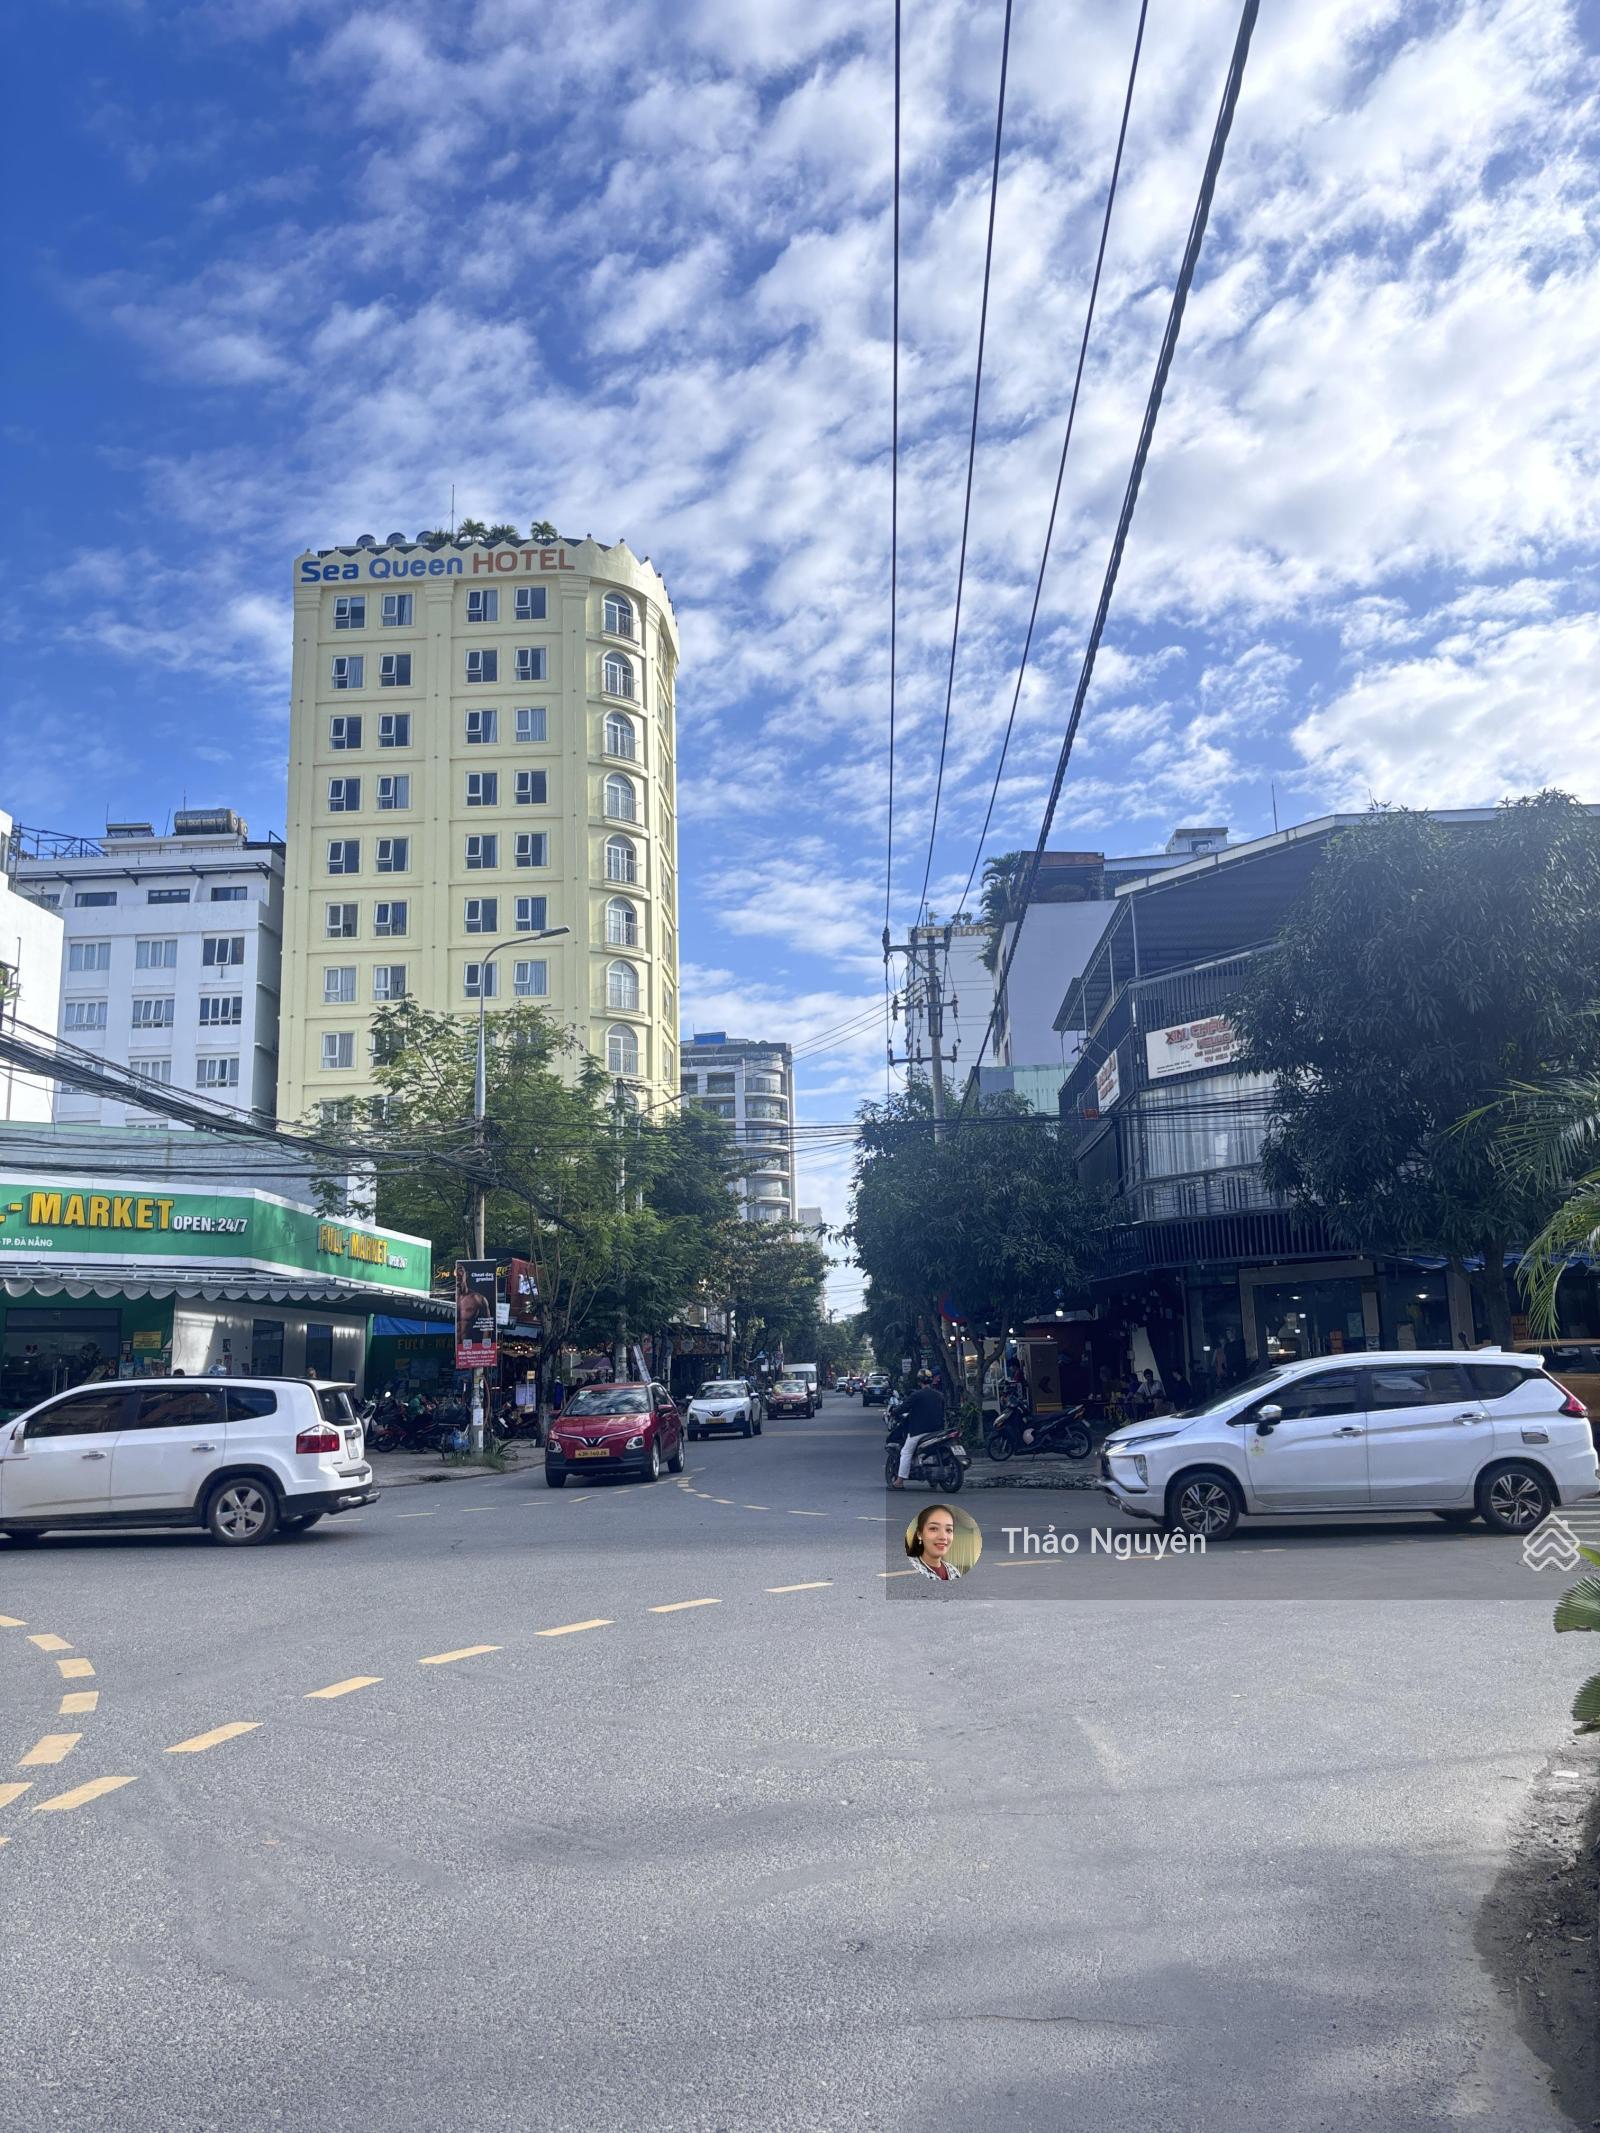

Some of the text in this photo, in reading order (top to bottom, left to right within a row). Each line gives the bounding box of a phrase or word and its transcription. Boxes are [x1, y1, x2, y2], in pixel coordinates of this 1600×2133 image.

[301, 549, 575, 582] Sea Queen HOTEL
[29, 1191, 175, 1230] MARKET
[173, 1215, 248, 1233] OPEN: 24/7
[318, 1224, 344, 1255] FULL
[349, 1232, 388, 1265] MARKET
